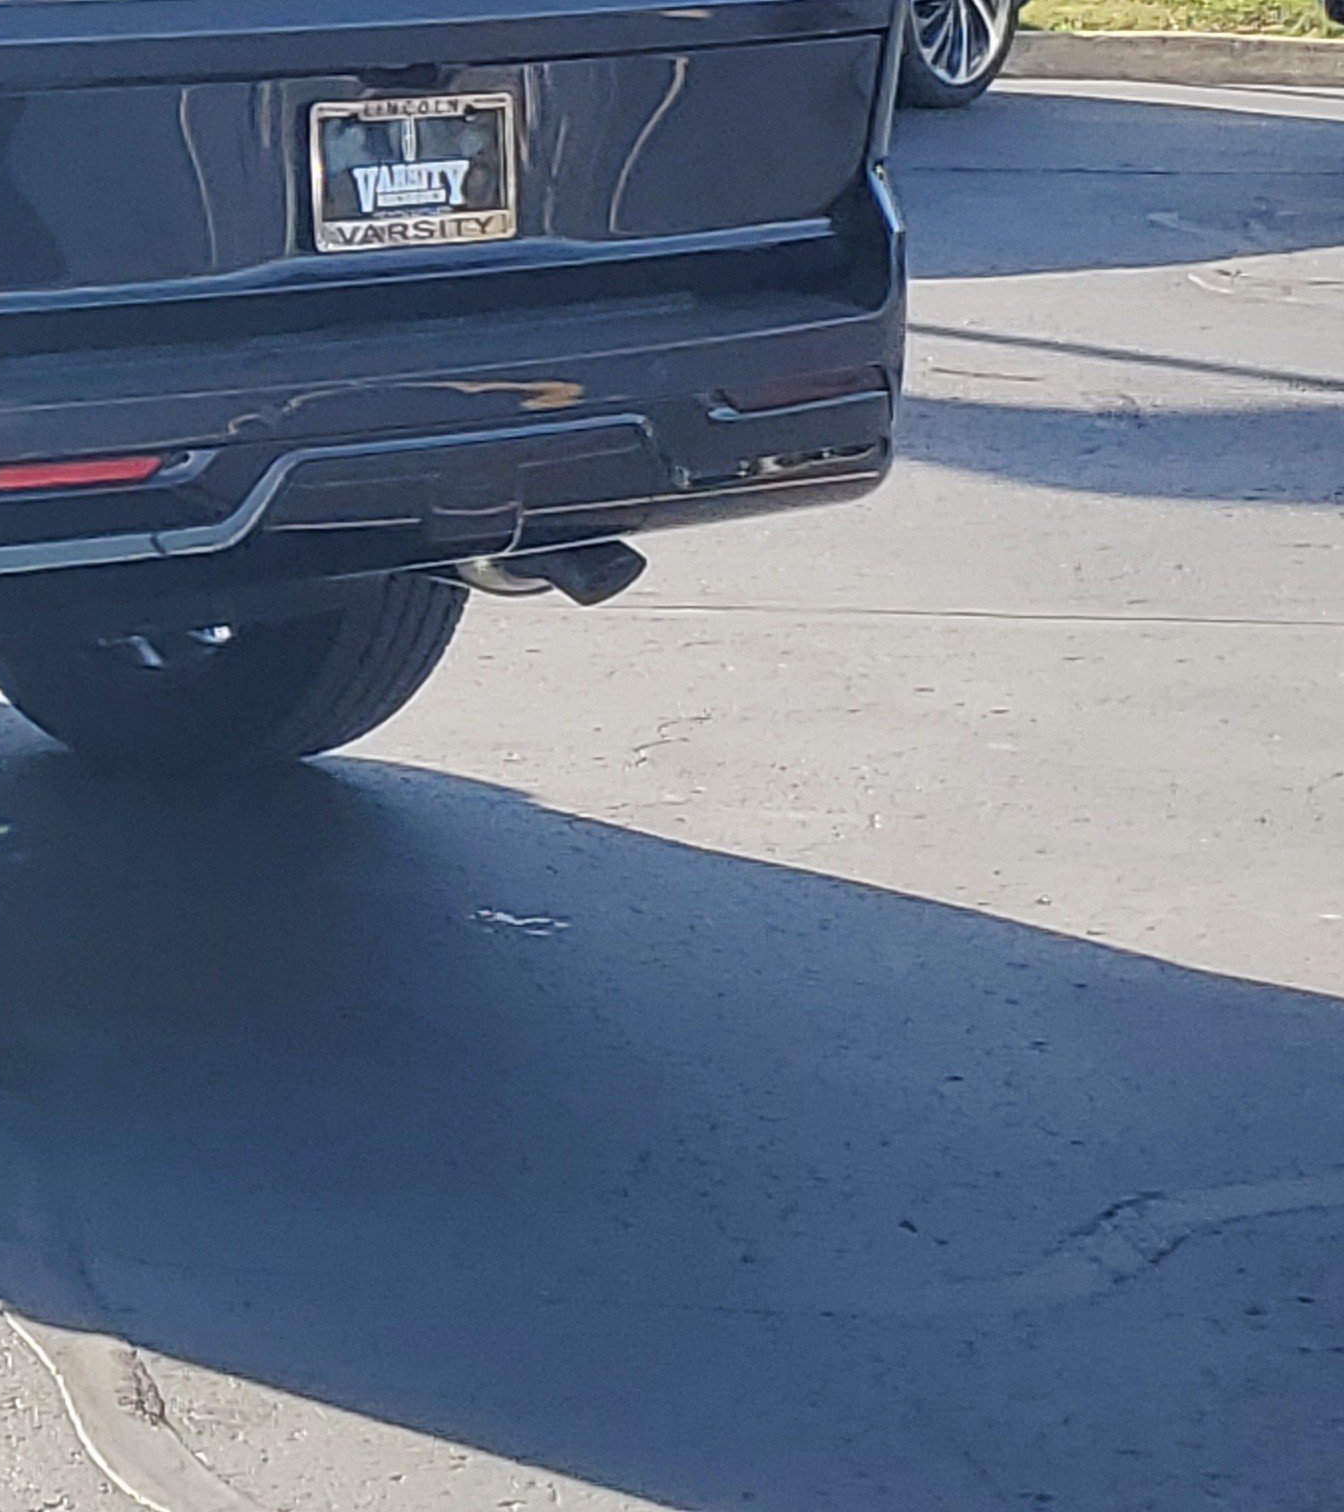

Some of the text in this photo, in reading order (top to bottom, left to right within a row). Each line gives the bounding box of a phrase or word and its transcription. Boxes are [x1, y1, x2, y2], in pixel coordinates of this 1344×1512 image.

[363, 98, 460, 117] LINCOLN
[352, 159, 470, 213] VARSITY
[336, 216, 494, 246] VARSITY
